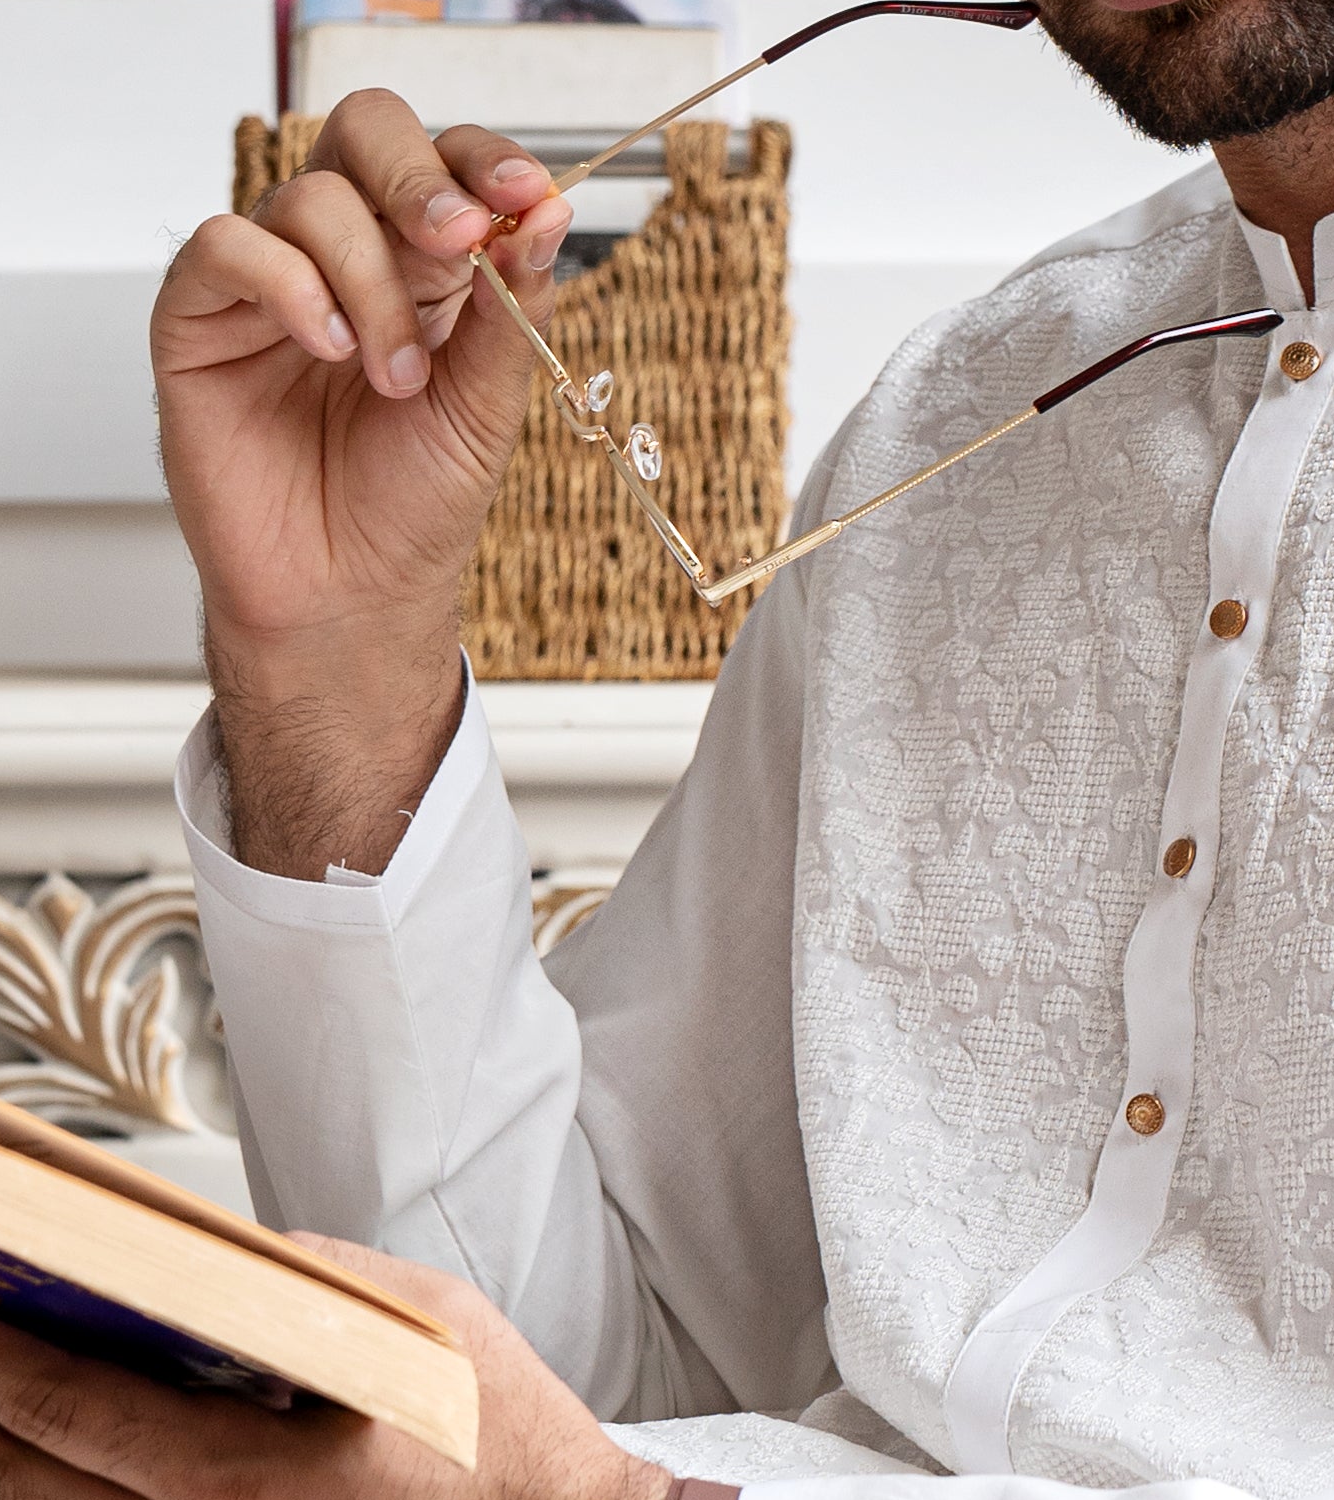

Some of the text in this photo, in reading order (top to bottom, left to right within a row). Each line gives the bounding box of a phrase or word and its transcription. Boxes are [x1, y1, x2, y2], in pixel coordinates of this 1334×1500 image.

[901, 4, 929, 15] Dior
[933, 9, 960, 18] MADE
[963, 10, 974, 20] IN
[976, 12, 1003, 23] ITALY
[764, 555, 790, 571] Dior
